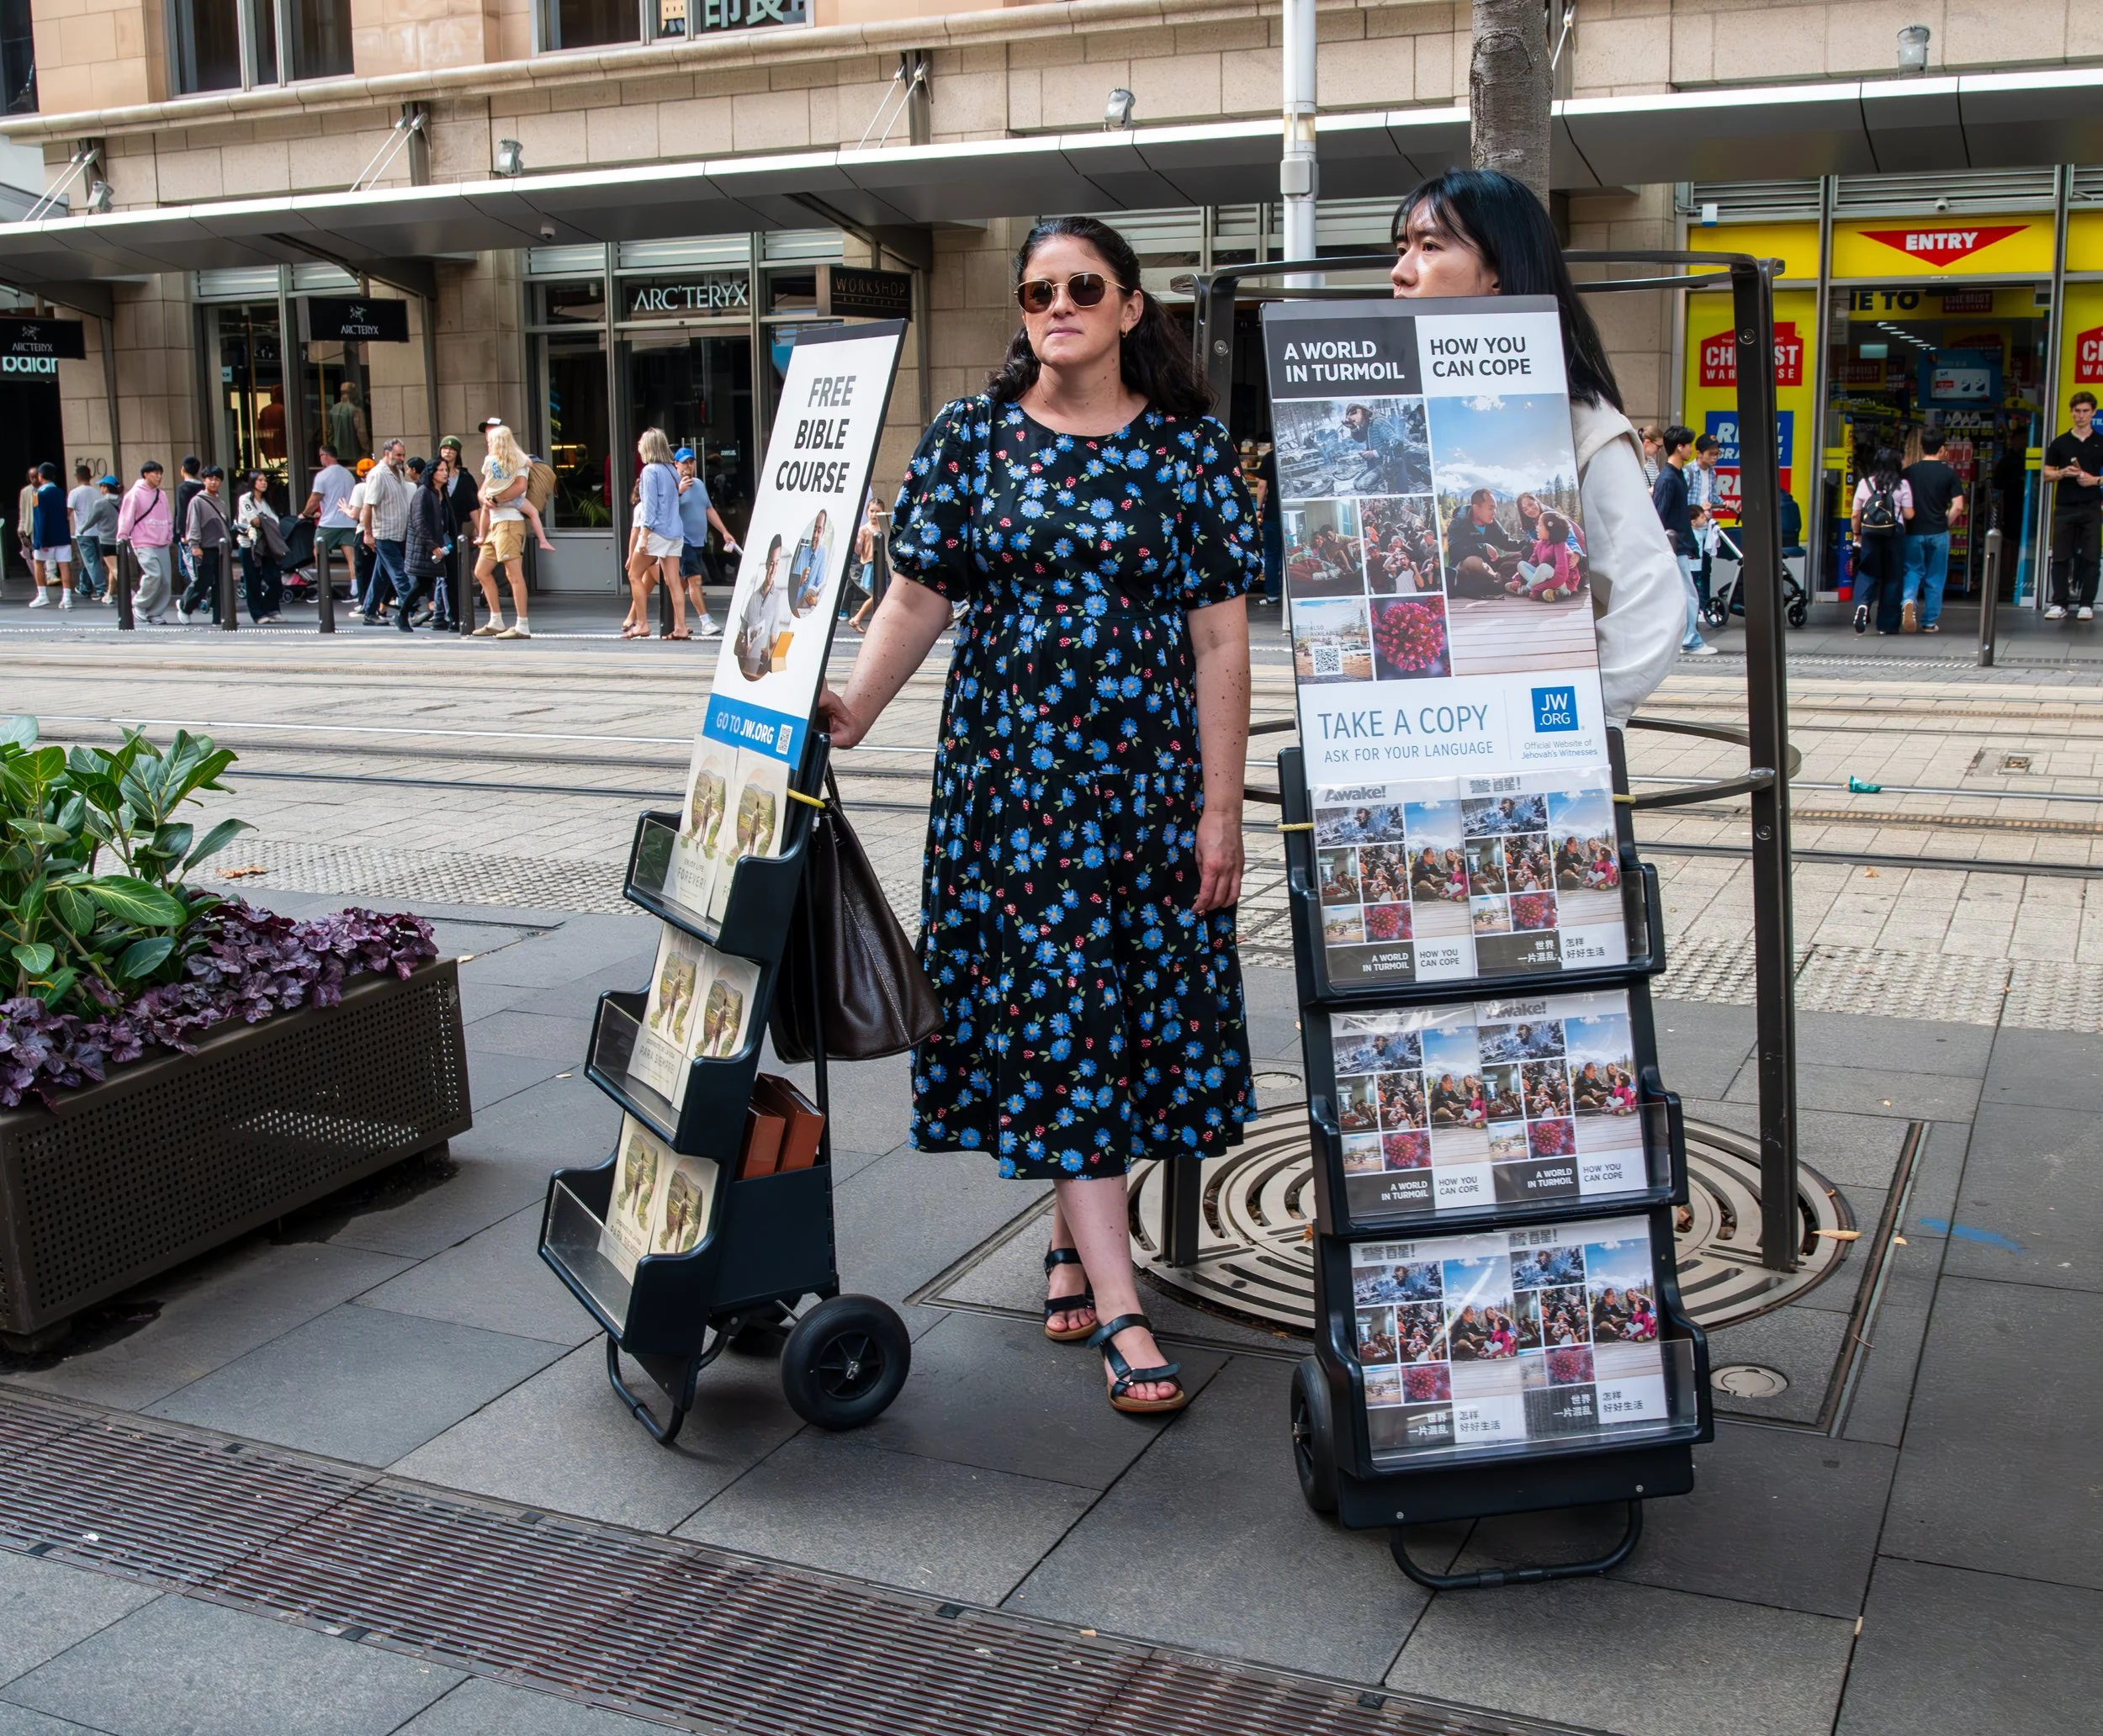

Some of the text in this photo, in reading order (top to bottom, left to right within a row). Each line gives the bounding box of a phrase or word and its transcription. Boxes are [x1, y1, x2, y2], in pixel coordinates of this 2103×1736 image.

[1905, 231, 1979, 251] ENTRY
[835, 277, 905, 296] WORKSHOP
[634, 283, 748, 310] ARC'TERYX
[1284, 341, 1377, 360] A WORLD
[1430, 336, 1526, 355] HOW YOU
[1706, 345, 1798, 366] CHST
[1285, 362, 1405, 382] IN TURMOIL
[1433, 358, 1532, 377] CAN COPE
[1706, 368, 1794, 379] WARSE
[808, 375, 856, 407] FREE
[794, 419, 850, 449] BIBLE
[776, 461, 850, 493] COURSE
[1541, 693, 1568, 711] JW
[1317, 704, 1487, 739] TAKE A COPY
[1540, 712, 1571, 726] .ORG
[716, 712, 775, 744] GO TO JW.ORG
[1524, 738, 1592, 750] Official Website of
[1324, 741, 1494, 763] ASK FOR YOUR LANGUAGE
[1521, 749, 1597, 760] Jehovah's Witnesses
[1324, 786, 1386, 802] Awake!
[1565, 937, 1584, 947] 怎样
[1371, 952, 1409, 963] A WORLD
[1442, 949, 1458, 957] YOU
[1566, 946, 1605, 959] 好好生活
[1362, 961, 1410, 972] IN TURMOIL
[1439, 957, 1459, 966] COPE
[1543, 1167, 1572, 1178] WORLD
[1583, 1165, 1602, 1173] HOW
[1438, 1178, 1458, 1186] HOW
[1527, 1177, 1573, 1188] IN TURMOIL
[1602, 1172, 1623, 1180] COPE
[1398, 1180, 1428, 1190] WORLD
[1439, 1185, 1479, 1195] CAN COPE
[1381, 1190, 1428, 1201] IN TURMOIL
[1602, 1391, 1622, 1400] 怎样
[1603, 1400, 1643, 1413] 好好生活
